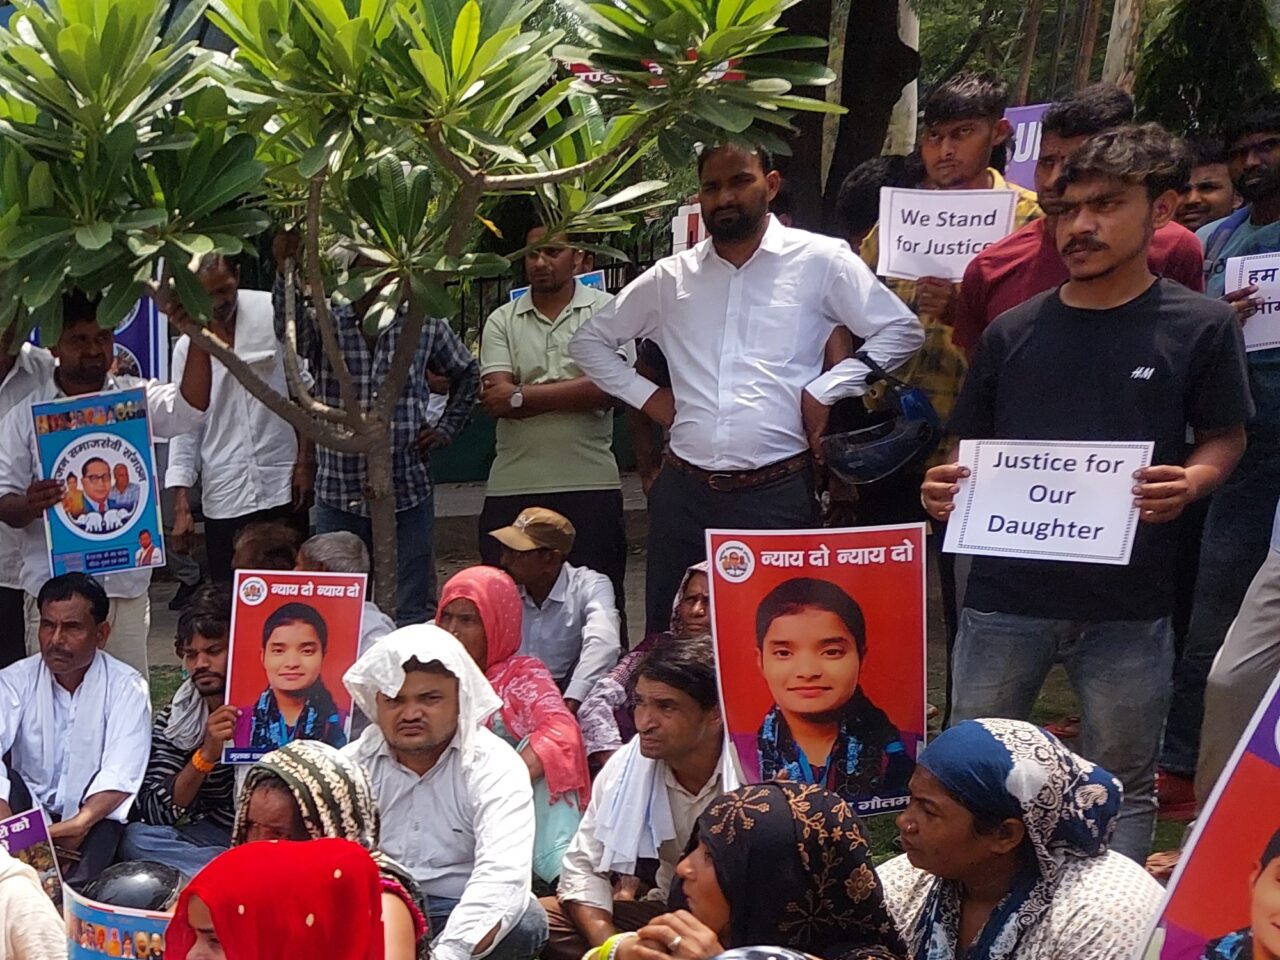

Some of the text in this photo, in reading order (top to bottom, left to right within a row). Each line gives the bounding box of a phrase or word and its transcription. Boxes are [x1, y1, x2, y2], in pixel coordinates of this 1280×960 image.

[901, 208, 997, 227] We Stand
[896, 235, 920, 253] for
[1248, 268, 1279, 286] हम
[993, 451, 1124, 474] Justice for
[1028, 484, 1076, 505] Our
[987, 514, 1105, 541] Daughter
[760, 551, 804, 567] न्याय
[808, 544, 830, 566] दो
[837, 547, 887, 564] न्याय
[890, 538, 915, 562] दो
[271, 581, 361, 597] न्याय दो न्याय दो
[858, 796, 912, 810] गौतम
